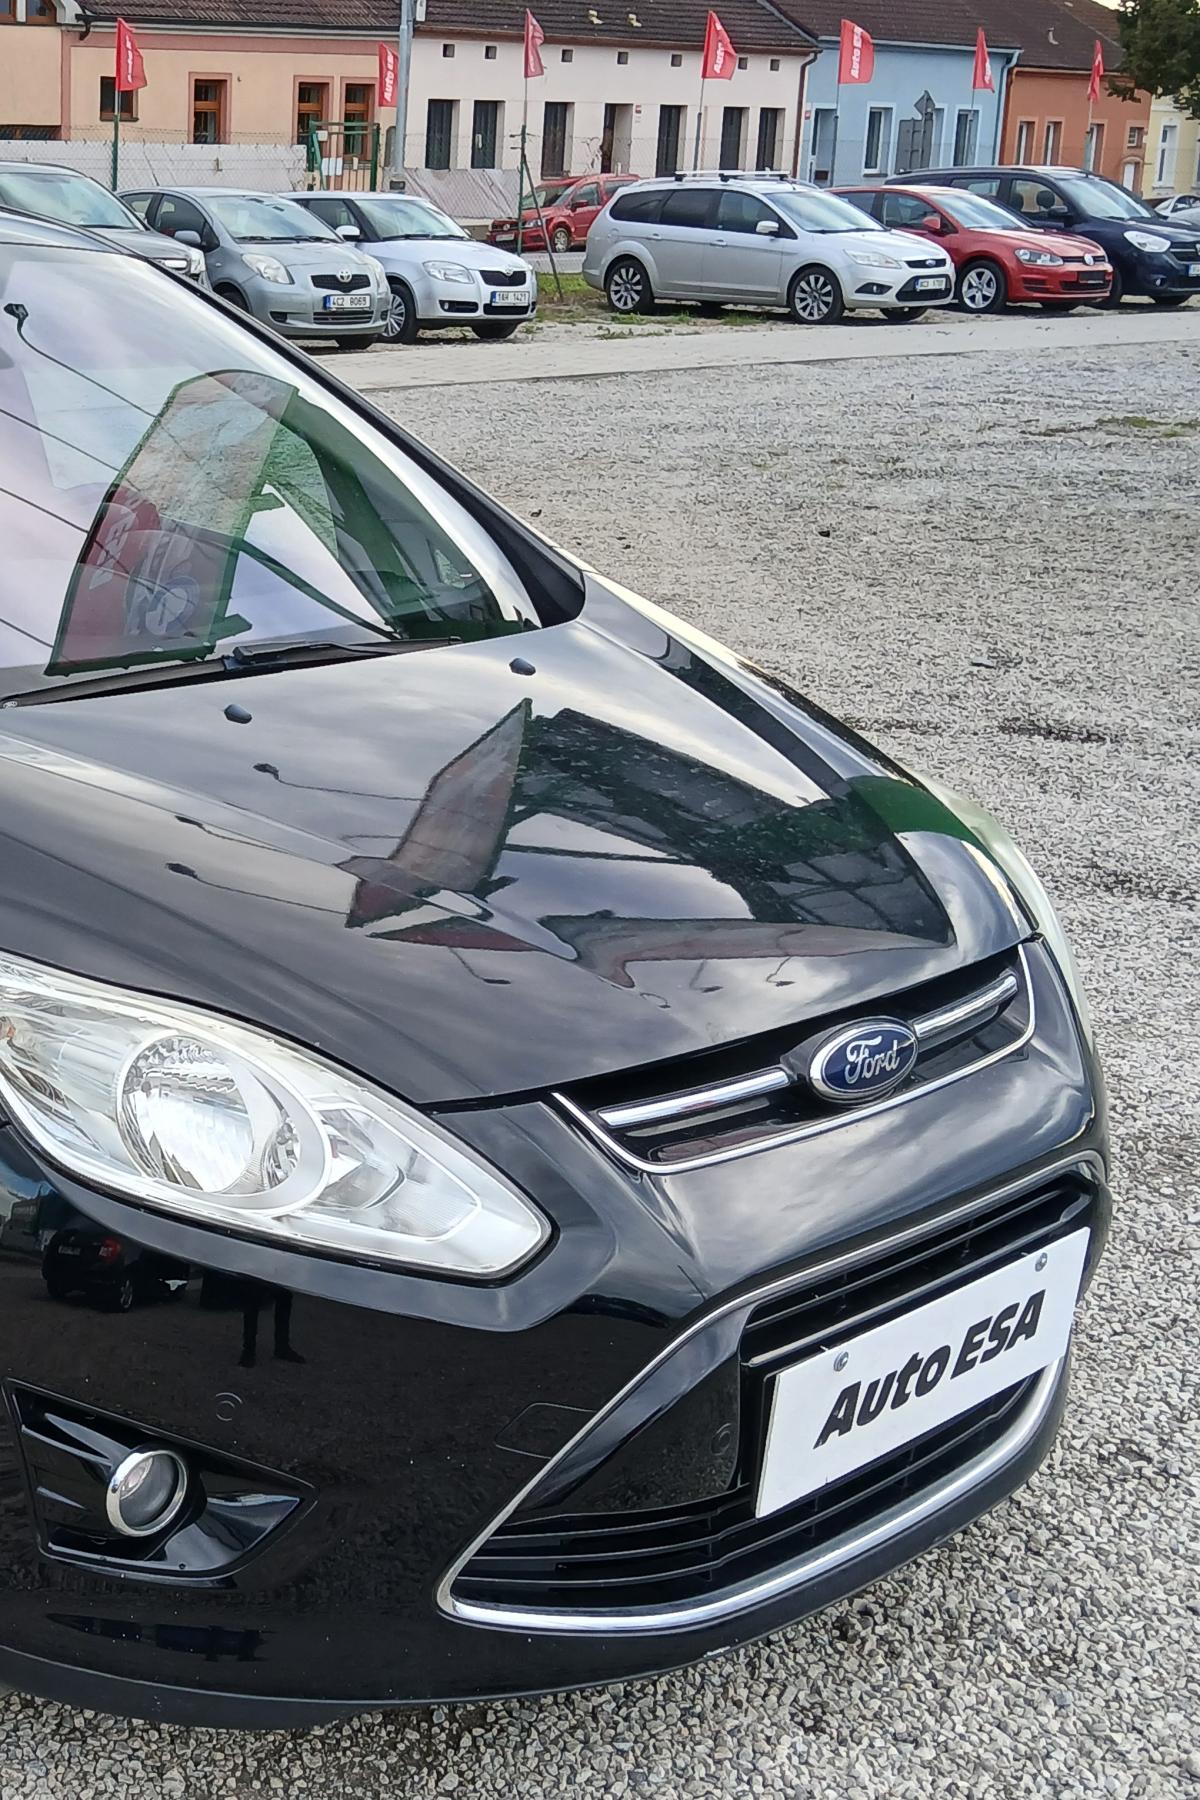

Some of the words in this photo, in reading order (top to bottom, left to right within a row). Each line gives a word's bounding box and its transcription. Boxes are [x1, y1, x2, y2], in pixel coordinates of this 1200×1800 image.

[844, 1035, 901, 1085] Ford
[813, 1345, 951, 1450] Auto
[950, 1289, 1046, 1379] ESA
